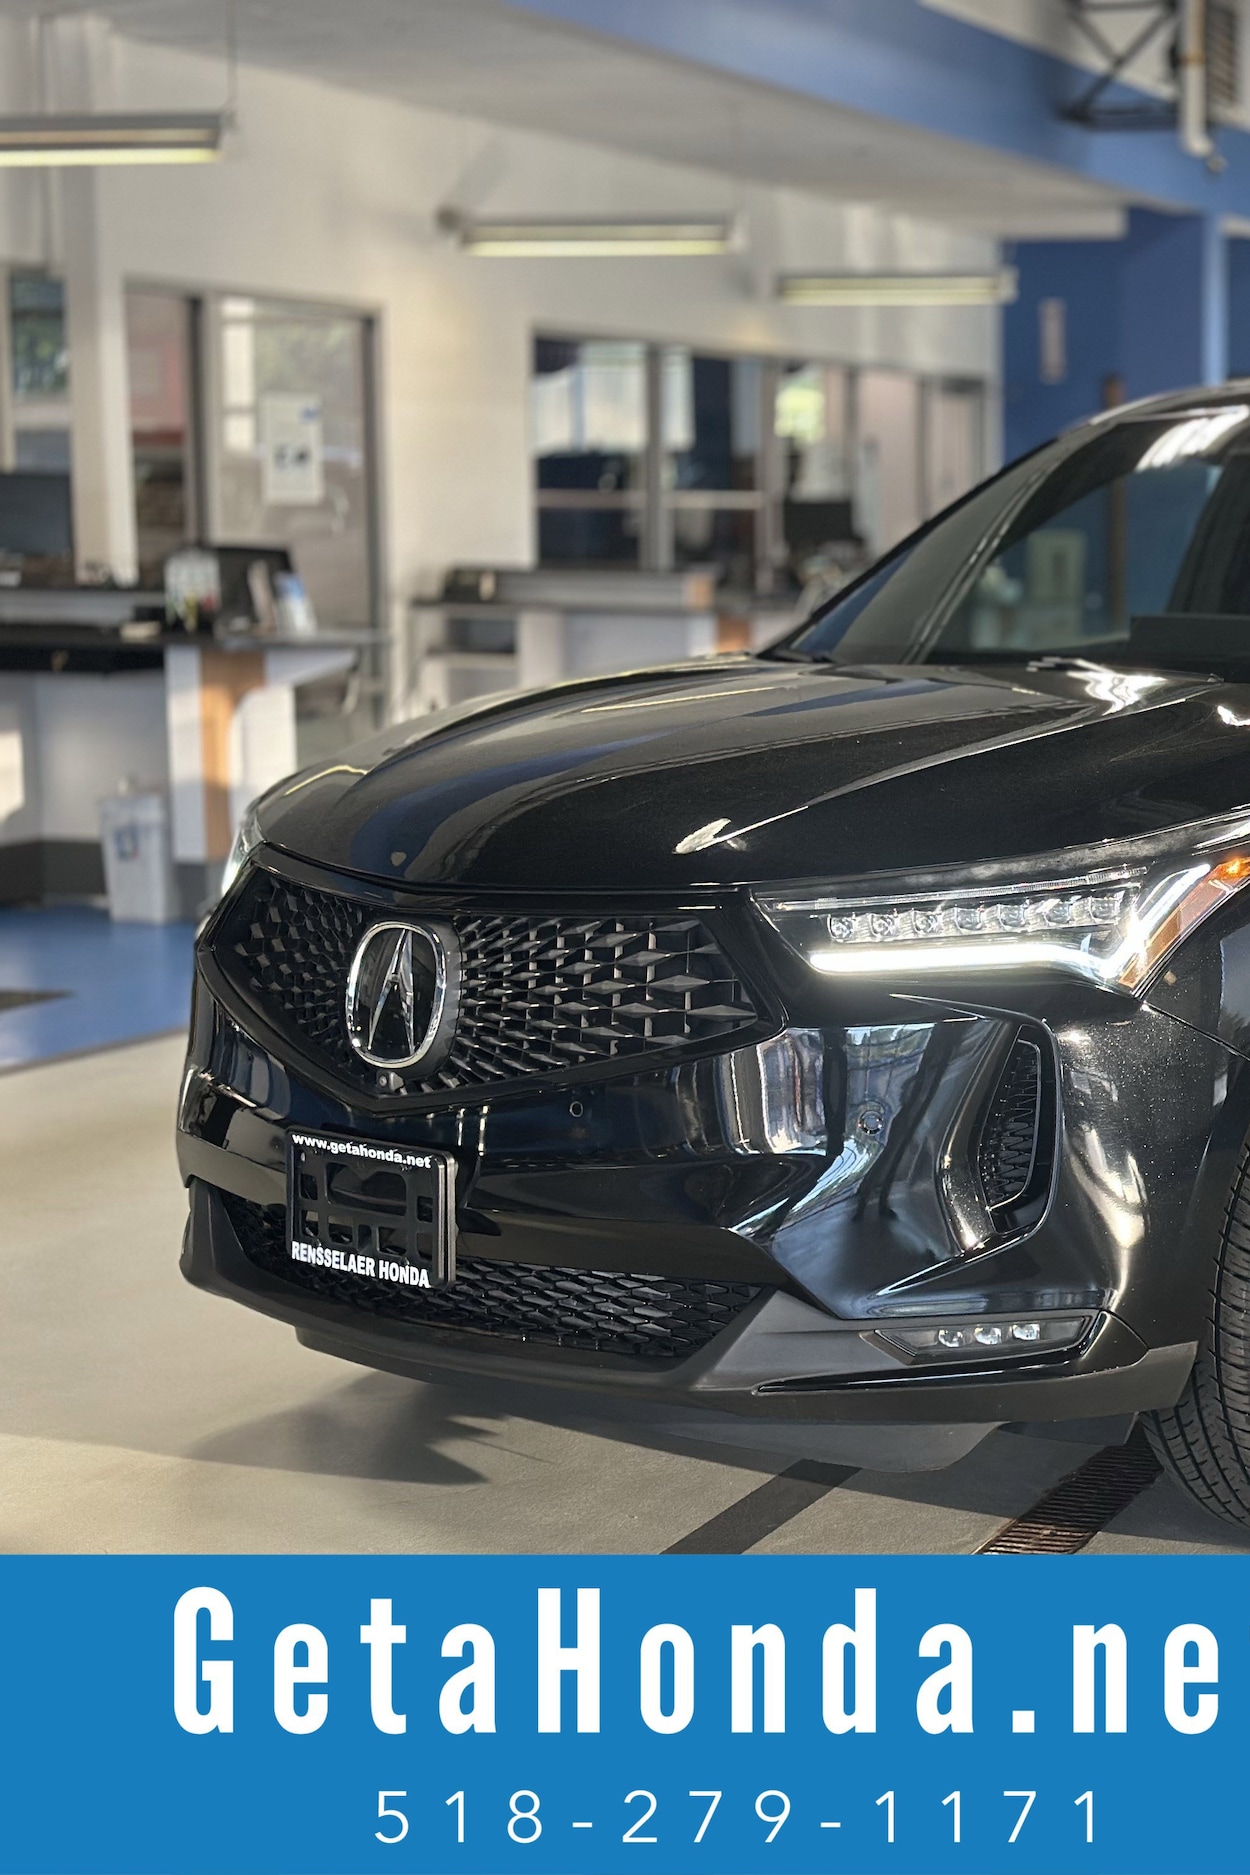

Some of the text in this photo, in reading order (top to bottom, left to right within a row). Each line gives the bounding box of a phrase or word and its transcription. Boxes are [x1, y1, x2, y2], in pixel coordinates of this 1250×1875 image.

[292, 1134, 432, 1169] www.getahonda.net
[291, 1240, 432, 1289] RENSSELAER HONDA
